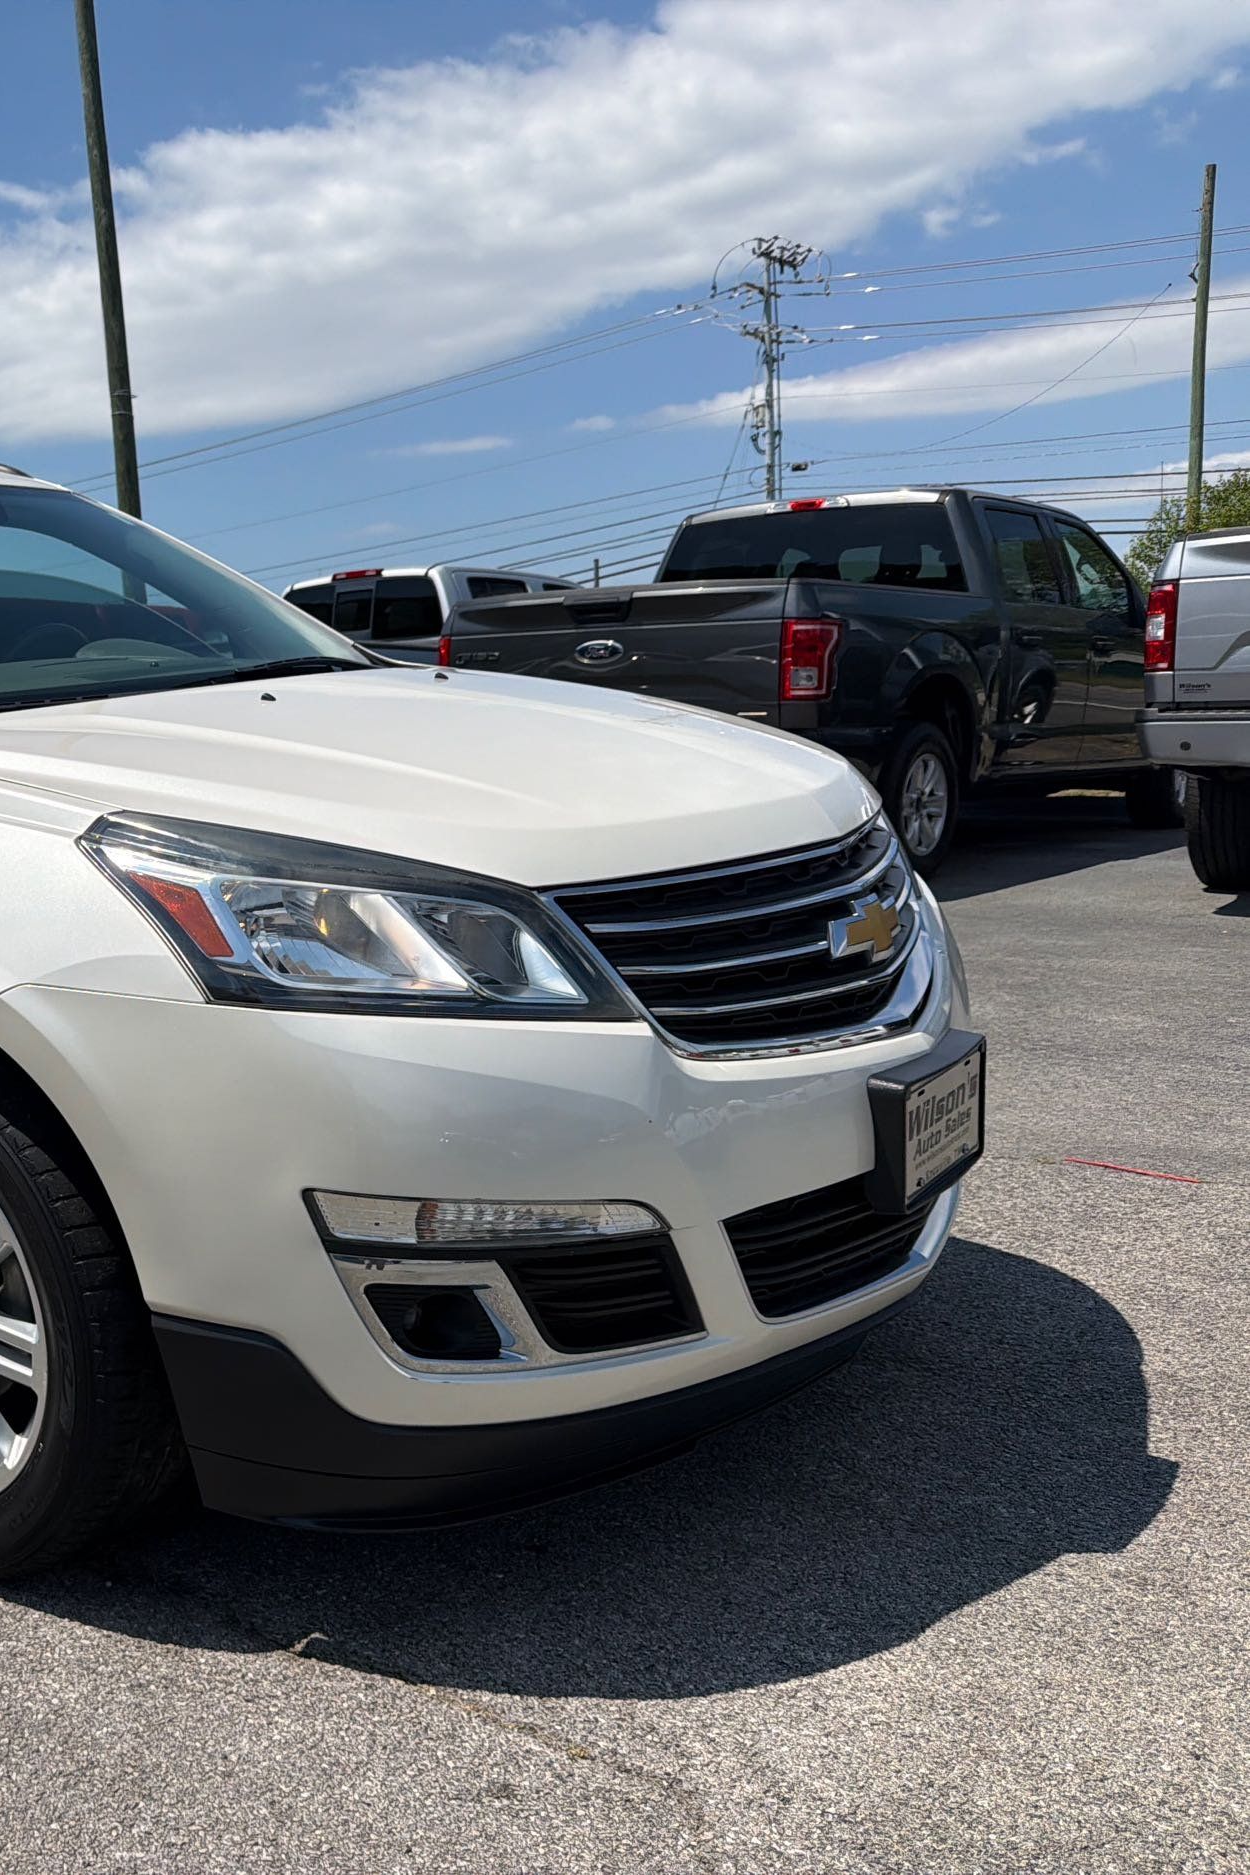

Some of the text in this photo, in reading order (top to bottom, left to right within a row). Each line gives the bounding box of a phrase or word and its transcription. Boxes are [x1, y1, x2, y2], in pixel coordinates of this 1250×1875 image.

[908, 1072, 979, 1141] Wilson's
[913, 1128, 941, 1161] Auto
[944, 1106, 971, 1138] Sales
